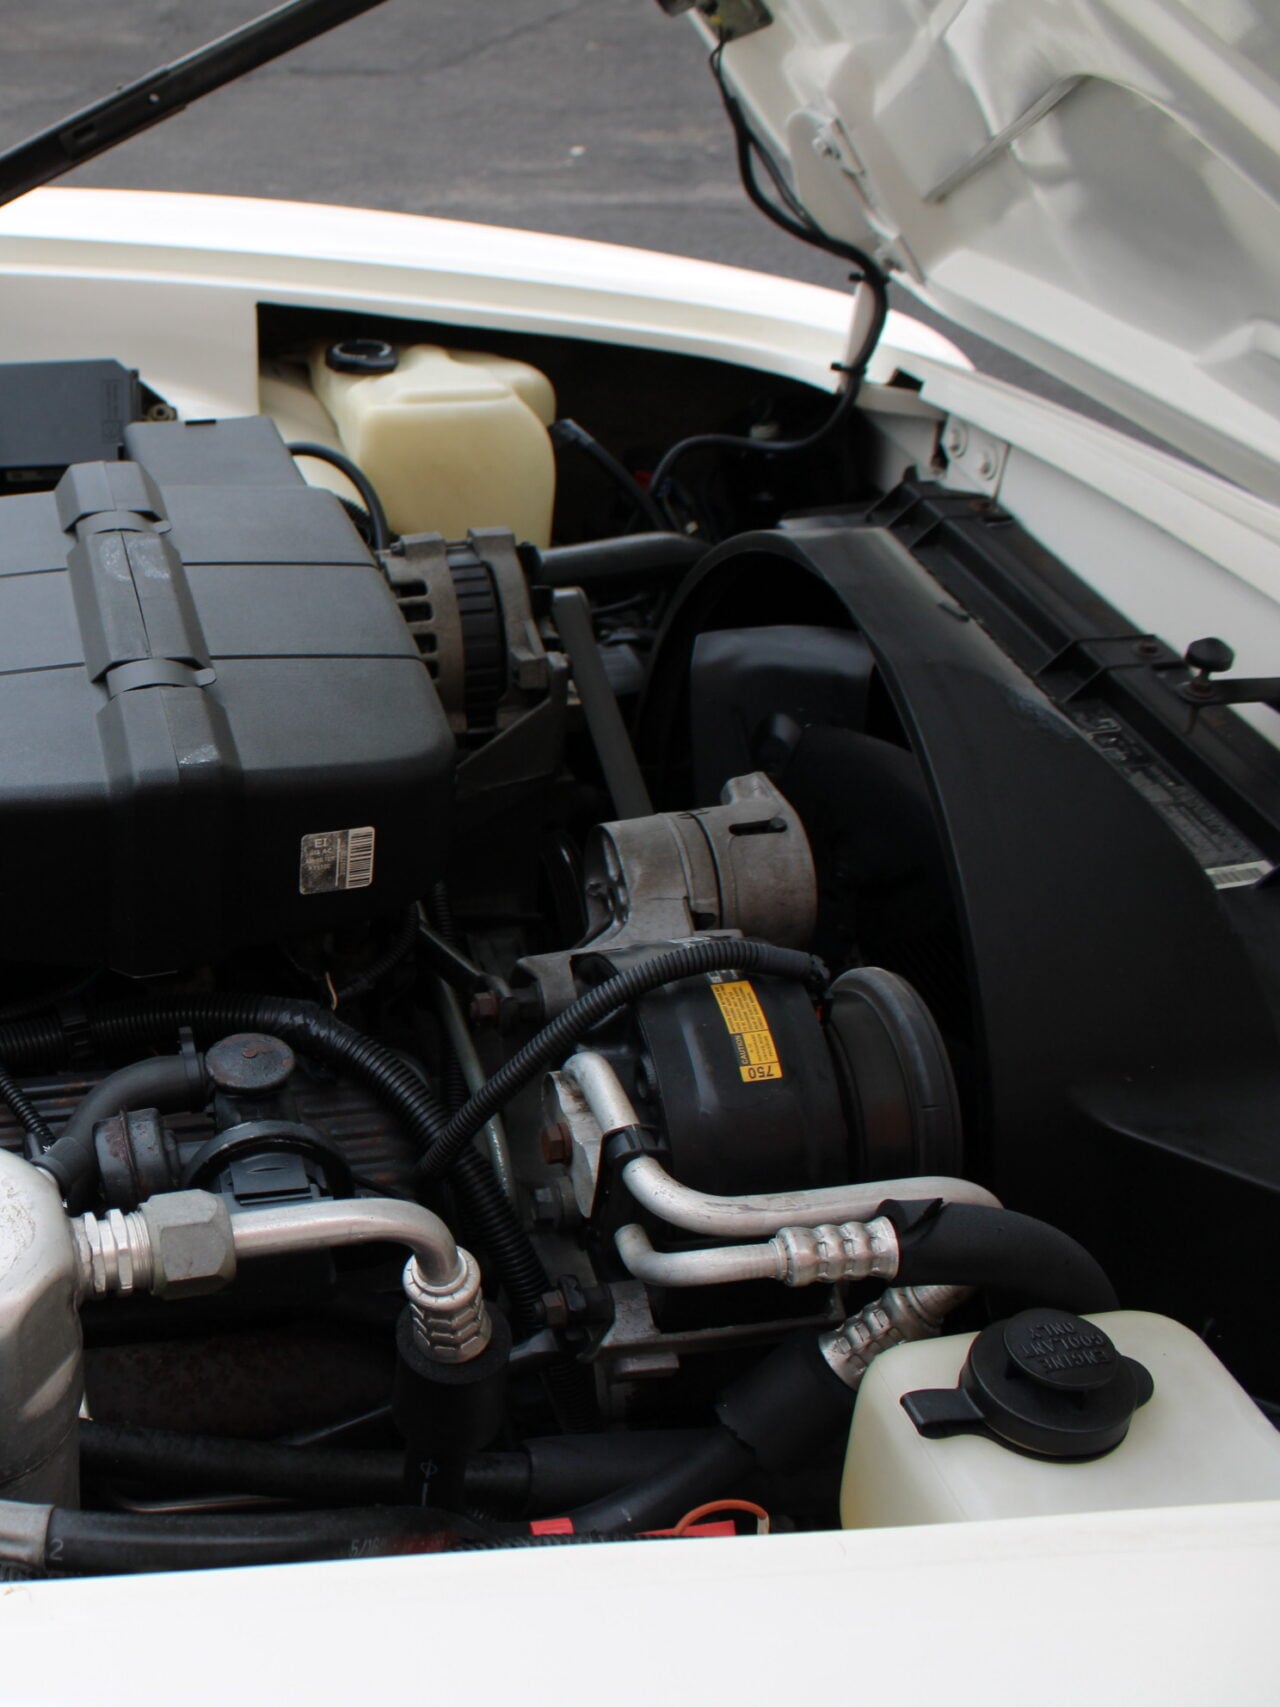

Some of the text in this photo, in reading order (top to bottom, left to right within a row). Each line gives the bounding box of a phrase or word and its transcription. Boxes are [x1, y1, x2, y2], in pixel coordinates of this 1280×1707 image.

[735, 1034, 750, 1065] CAUTION
[748, 1066, 775, 1079] 750
[1029, 1321, 1075, 1338] ONLY
[1021, 1334, 1104, 1355] COOLANT
[1042, 1351, 1107, 1369] ENGINE
[49, 1538, 64, 1561] 2
